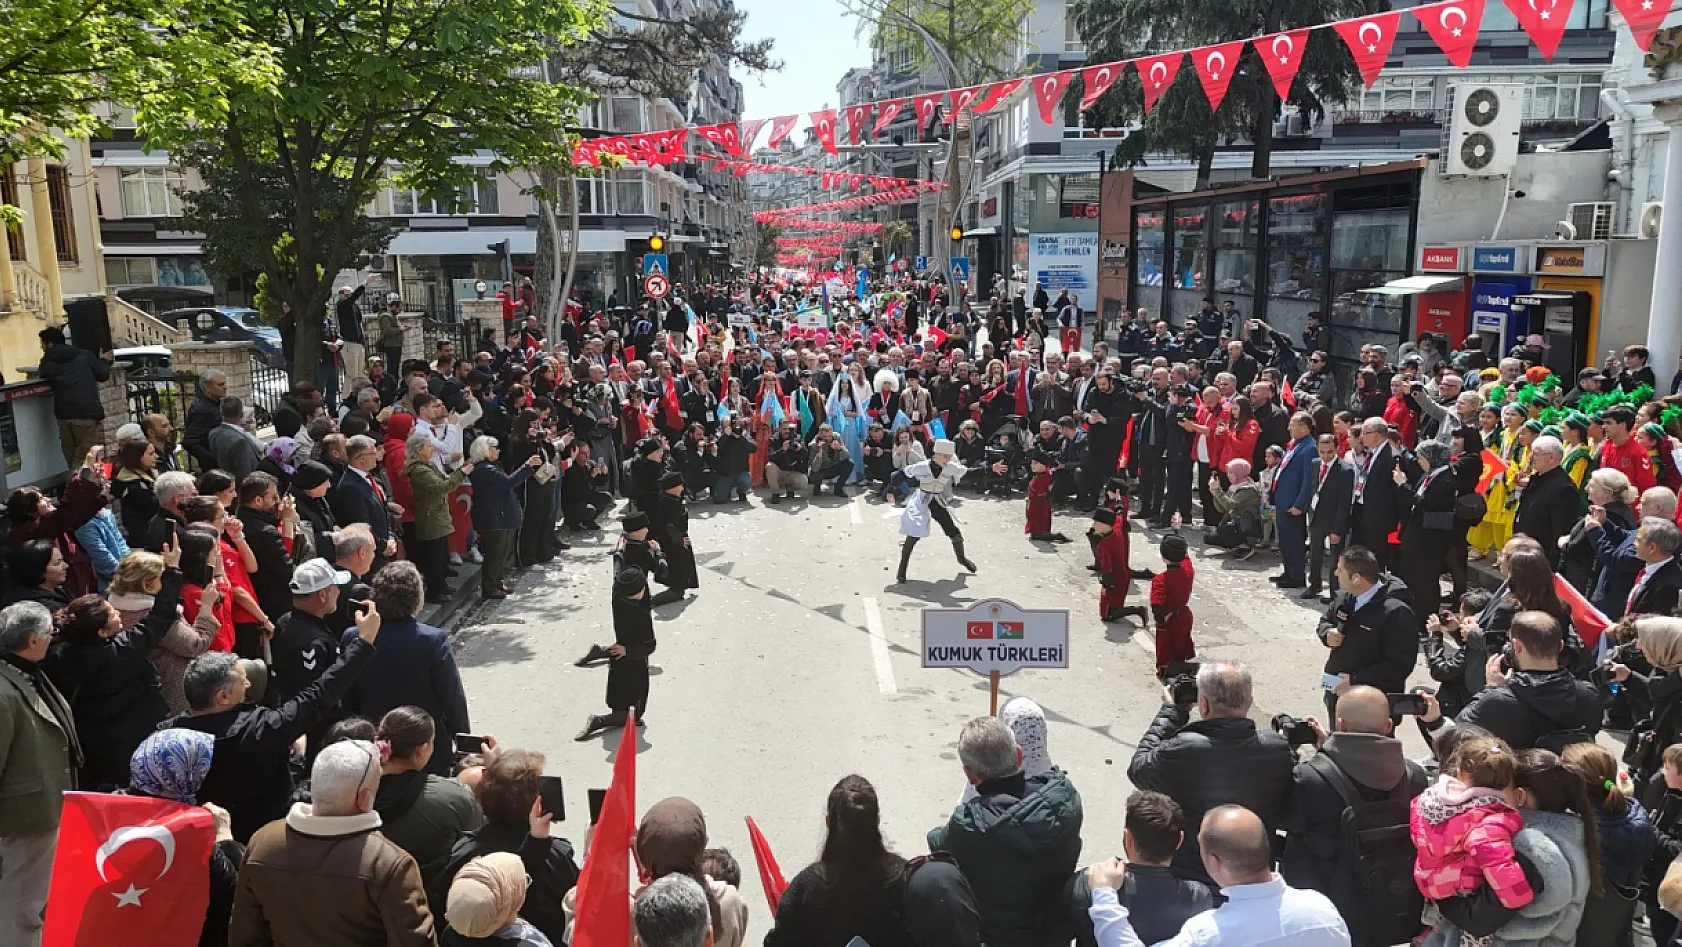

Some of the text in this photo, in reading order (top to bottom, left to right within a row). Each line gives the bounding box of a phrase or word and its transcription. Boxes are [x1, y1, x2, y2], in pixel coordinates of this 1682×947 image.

[1426, 254, 1454, 263] AKBANK
[928, 644, 1063, 662] KUMUK TÜRKLERİ
